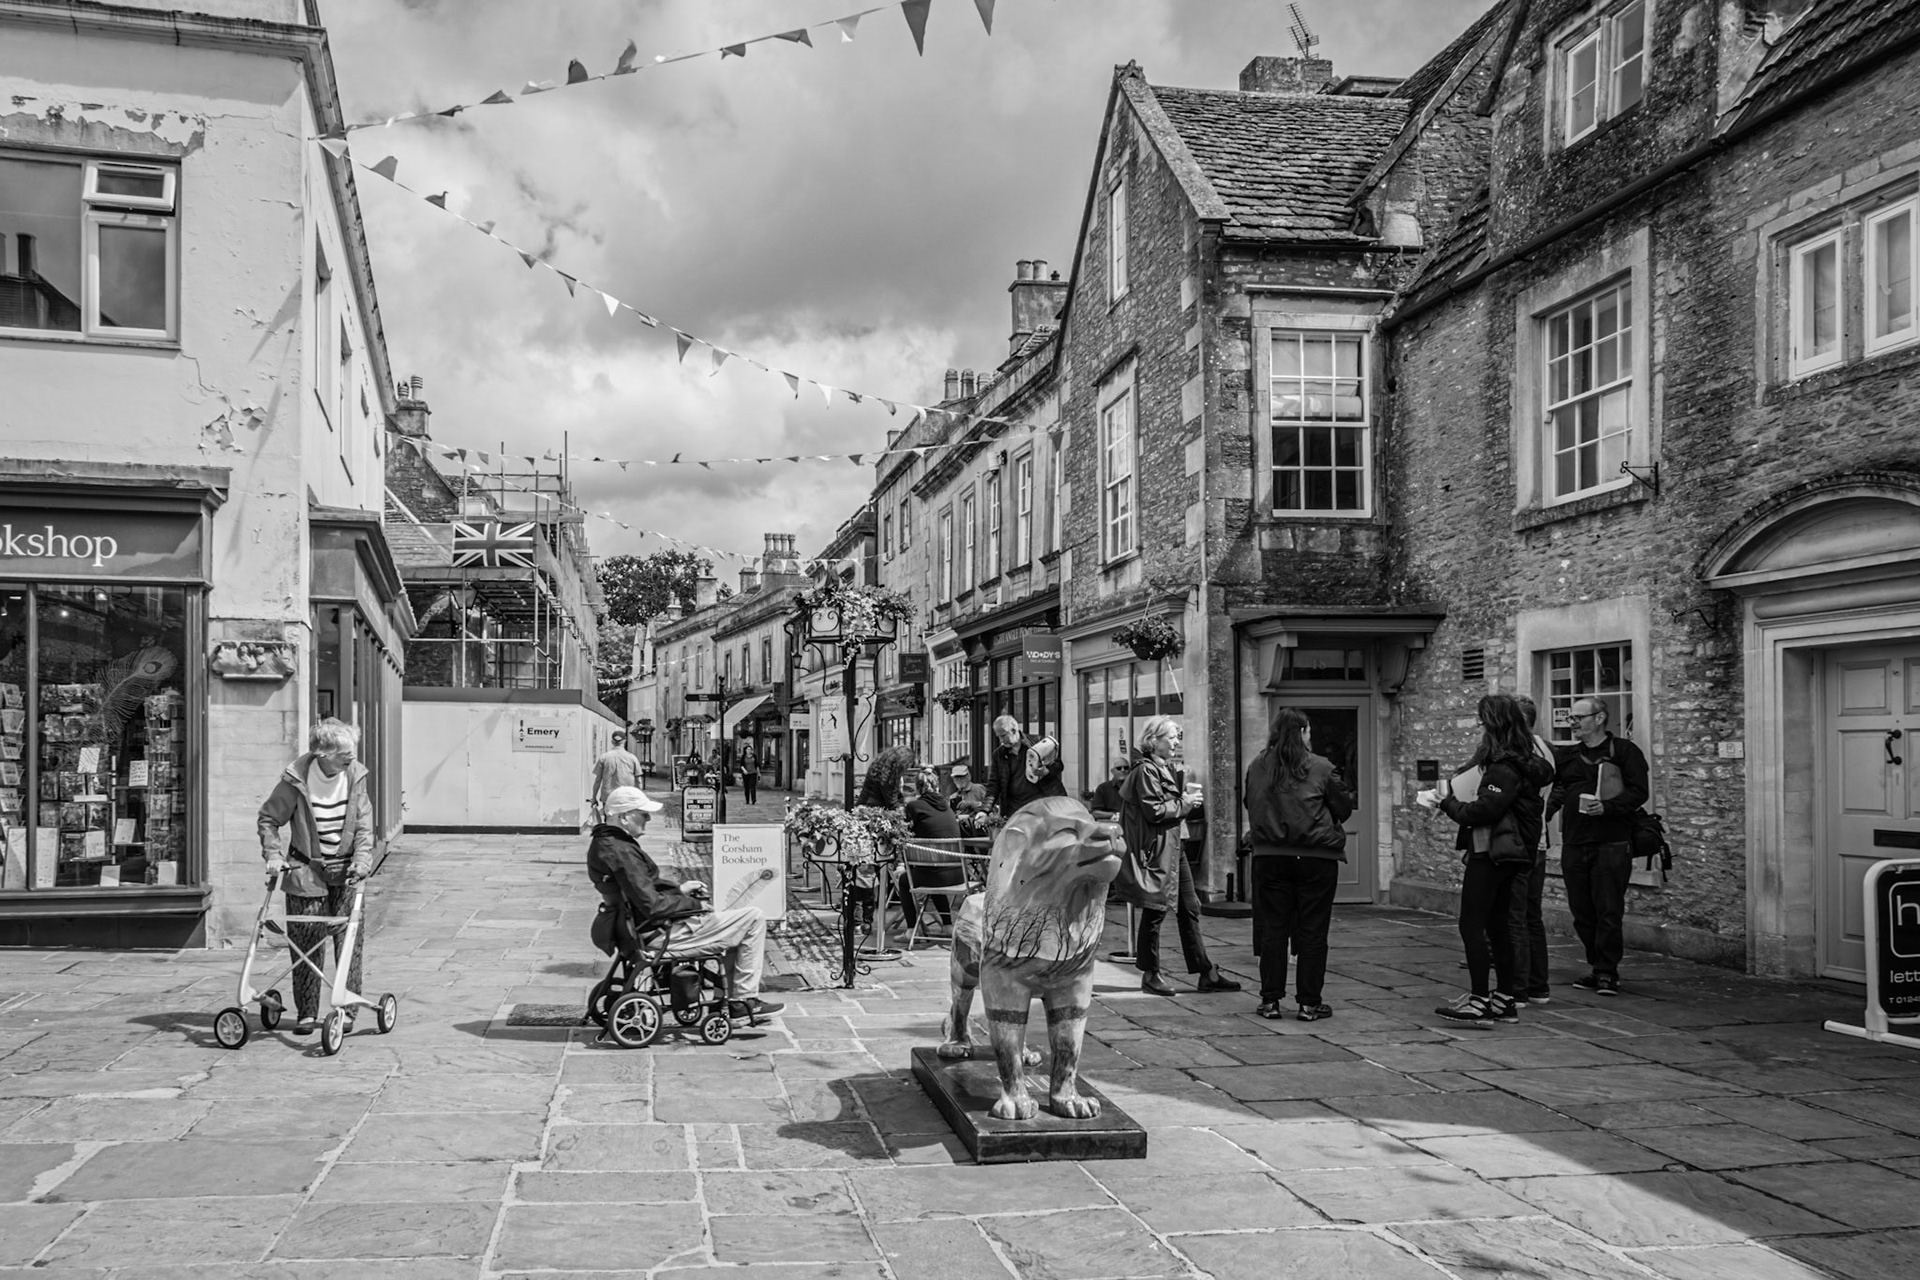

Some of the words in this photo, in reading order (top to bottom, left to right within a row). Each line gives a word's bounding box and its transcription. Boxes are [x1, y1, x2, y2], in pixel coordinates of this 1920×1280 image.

[0, 524, 118, 567] kshop
[527, 727, 560, 739] Emery
[722, 834, 741, 842] The
[721, 844, 762, 853] Corsham
[722, 855, 767, 866] Bookshop
